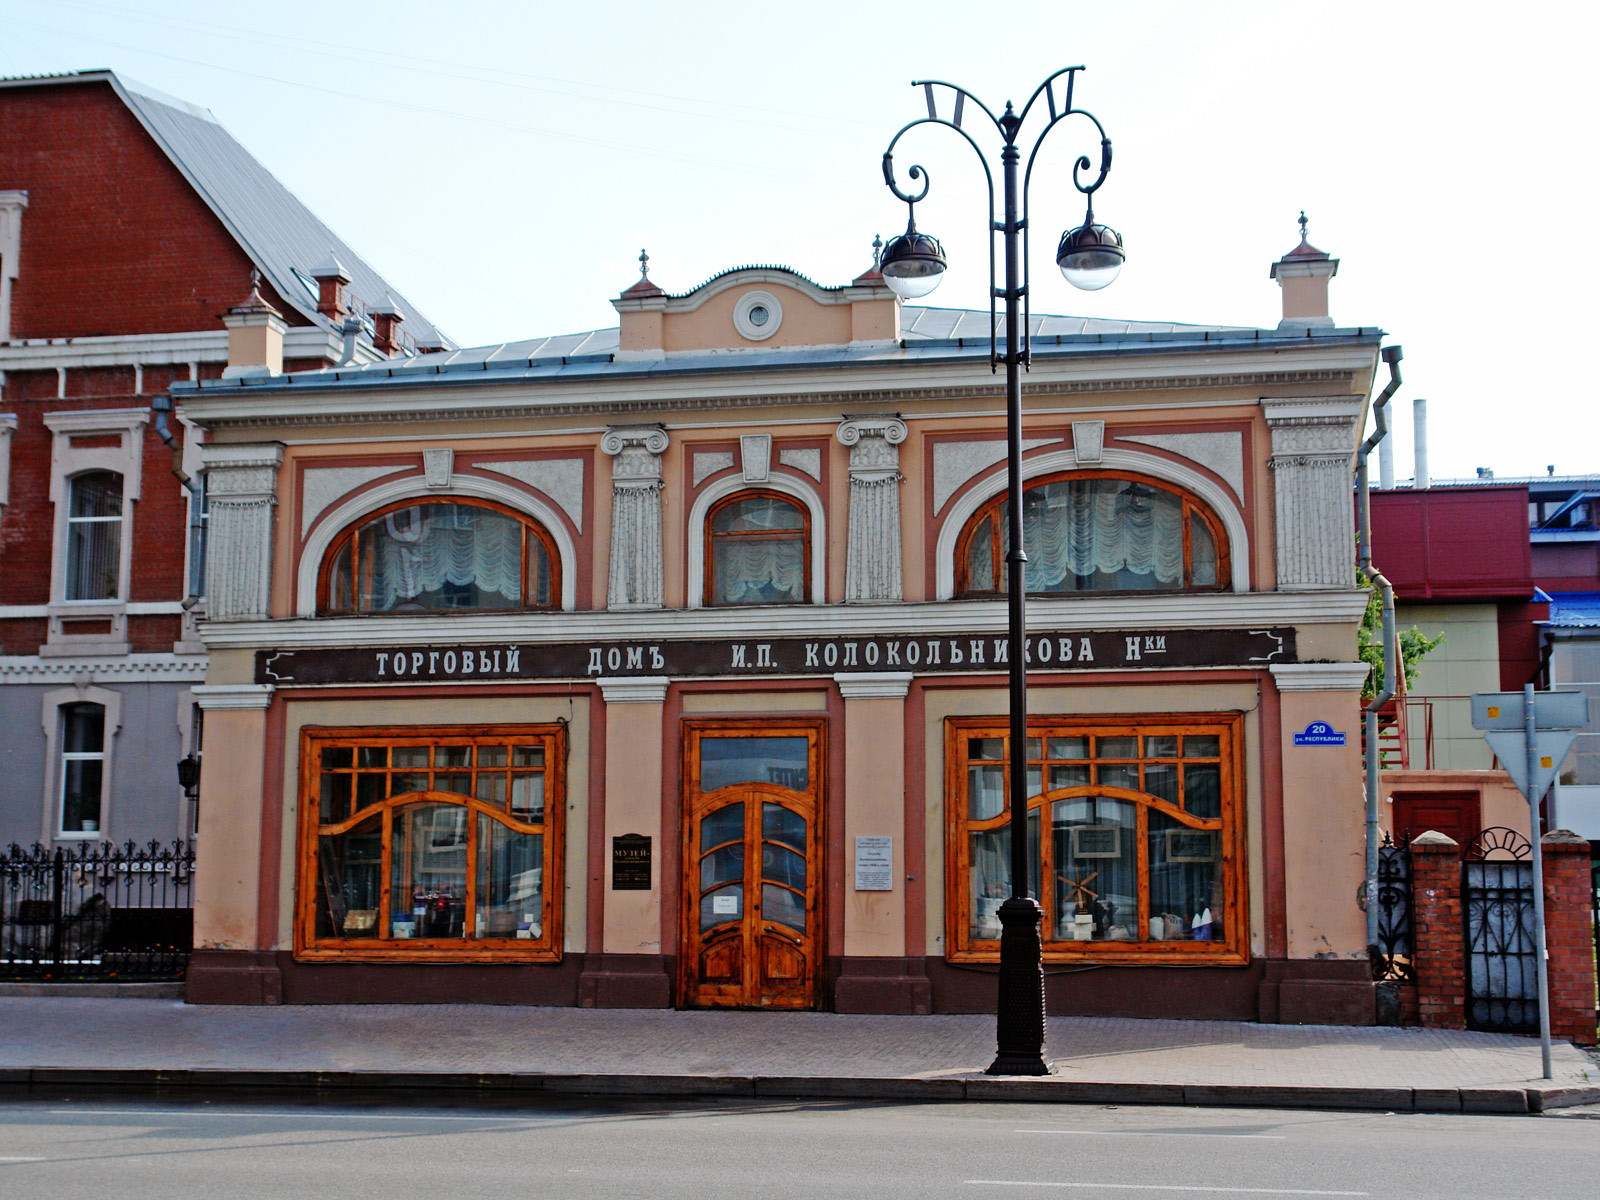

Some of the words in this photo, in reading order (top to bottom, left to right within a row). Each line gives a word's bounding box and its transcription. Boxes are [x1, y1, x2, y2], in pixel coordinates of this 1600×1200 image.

[376, 645, 520, 675] ТОРГОВЫЙ
[588, 646, 665, 675] ДОМЪ
[731, 645, 778, 668] И.П.
[1312, 725, 1326, 734] 20
